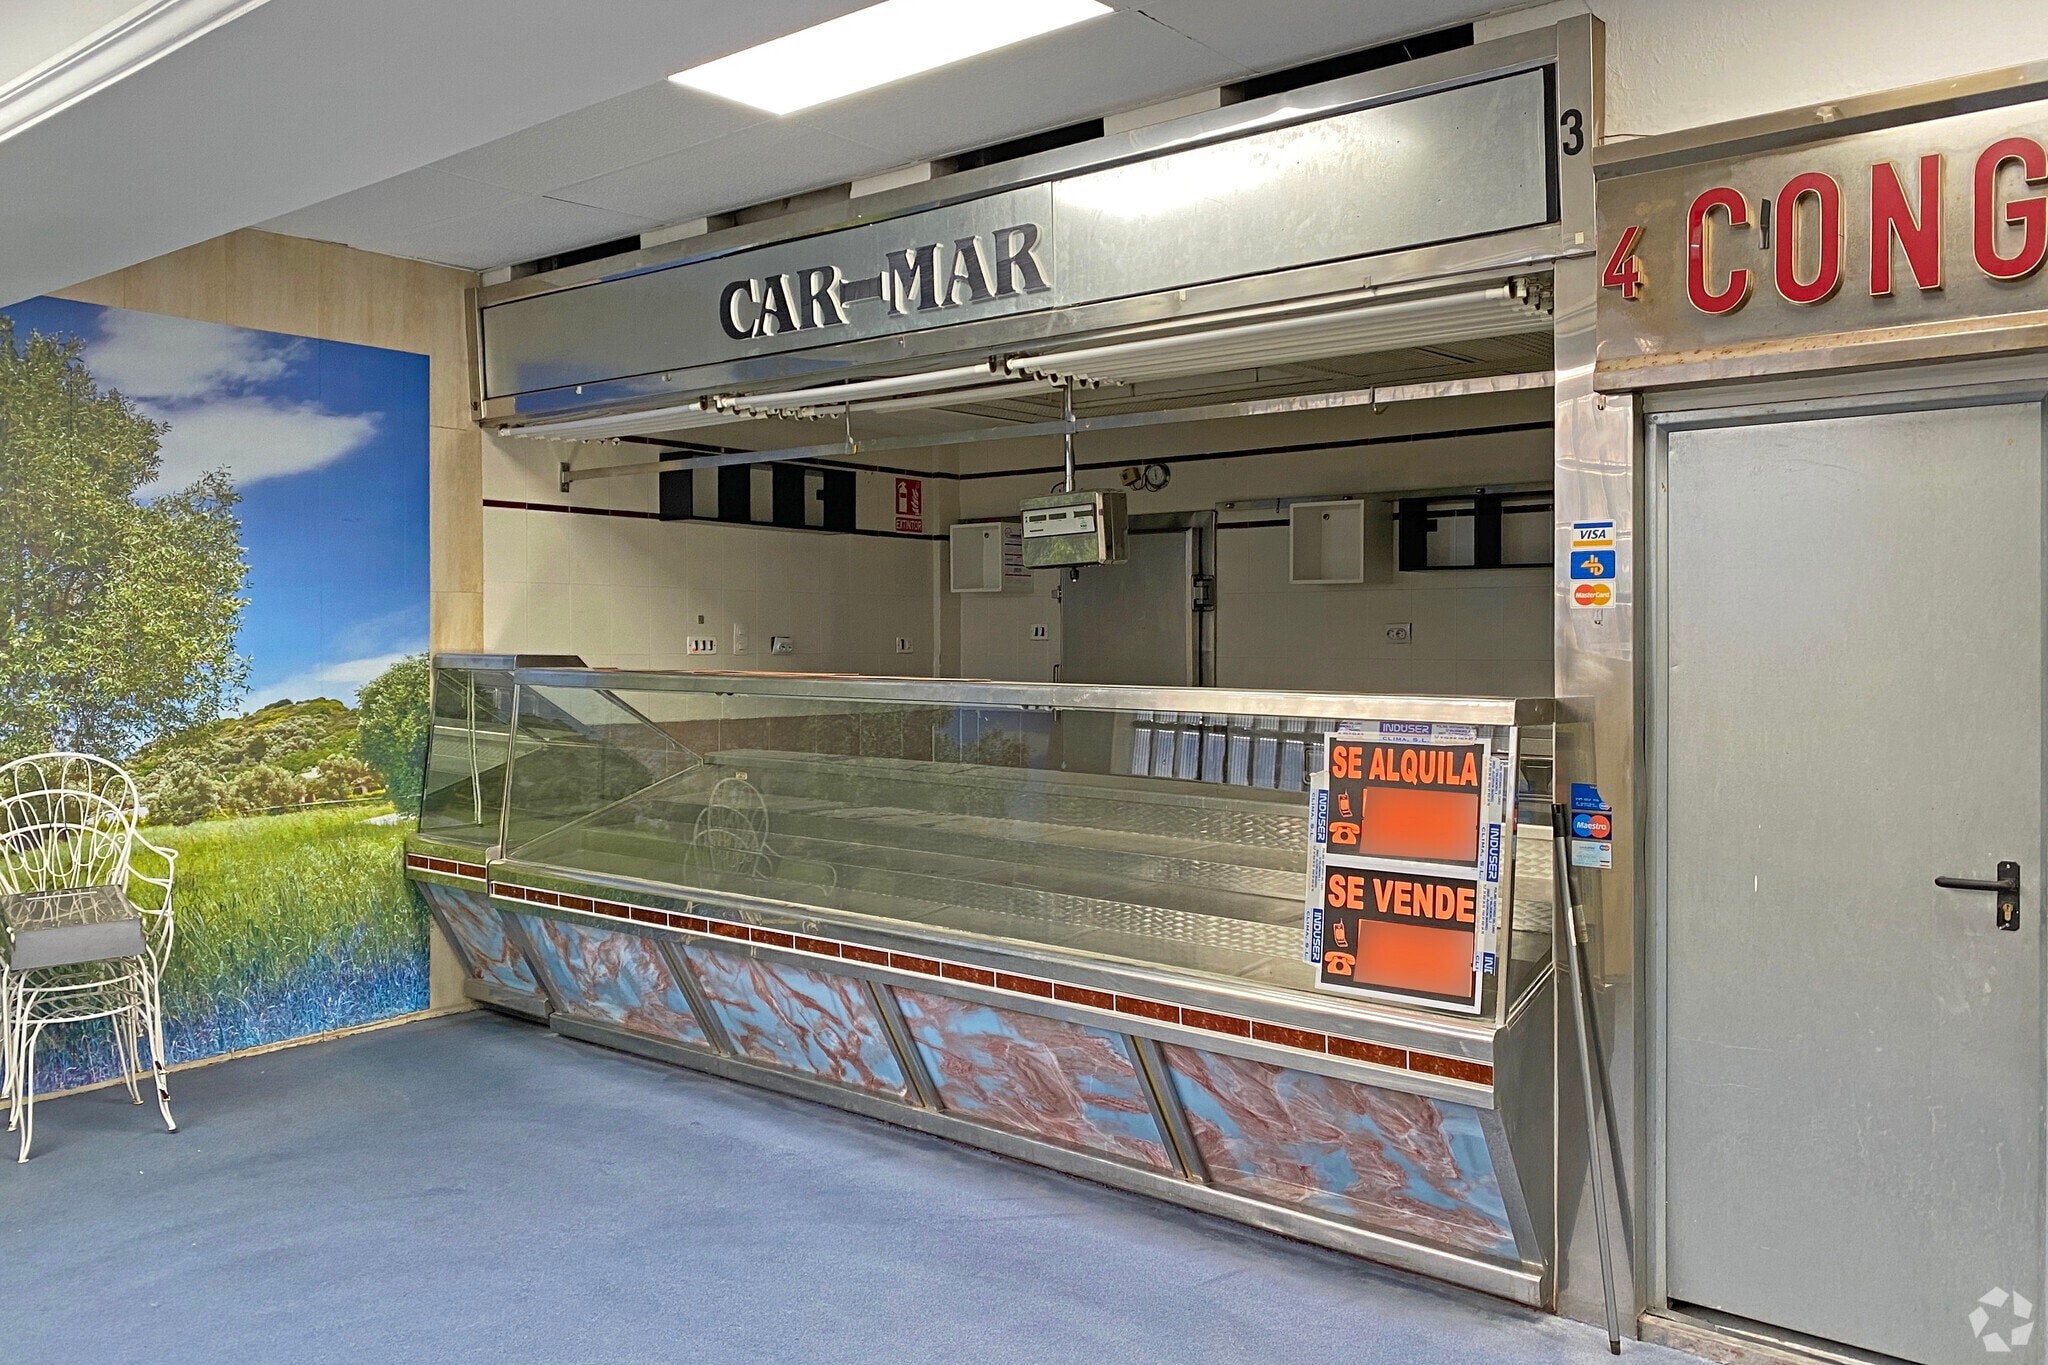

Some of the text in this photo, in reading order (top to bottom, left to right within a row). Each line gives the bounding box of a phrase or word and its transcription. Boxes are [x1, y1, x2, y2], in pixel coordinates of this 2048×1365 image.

[1560, 109, 1584, 156] 3
[1602, 137, 2048, 316] 4 CONG
[719, 223, 1052, 340] CAR-MAR
[896, 519, 922, 531] EXTINTOR
[1580, 529, 1606, 540] VISA
[1575, 591, 1610, 599] MasterCard
[1383, 723, 1430, 734] INDUSER
[1332, 745, 1363, 779] SE
[1369, 747, 1479, 787] ALQUILA
[1317, 793, 1327, 840] INDUSER
[1576, 821, 1607, 831] Maestro
[1488, 827, 1500, 880] INDUSER
[1328, 873, 1365, 910] SE
[1373, 878, 1476, 924] VENDE
[1312, 912, 1322, 961] INDUSER
